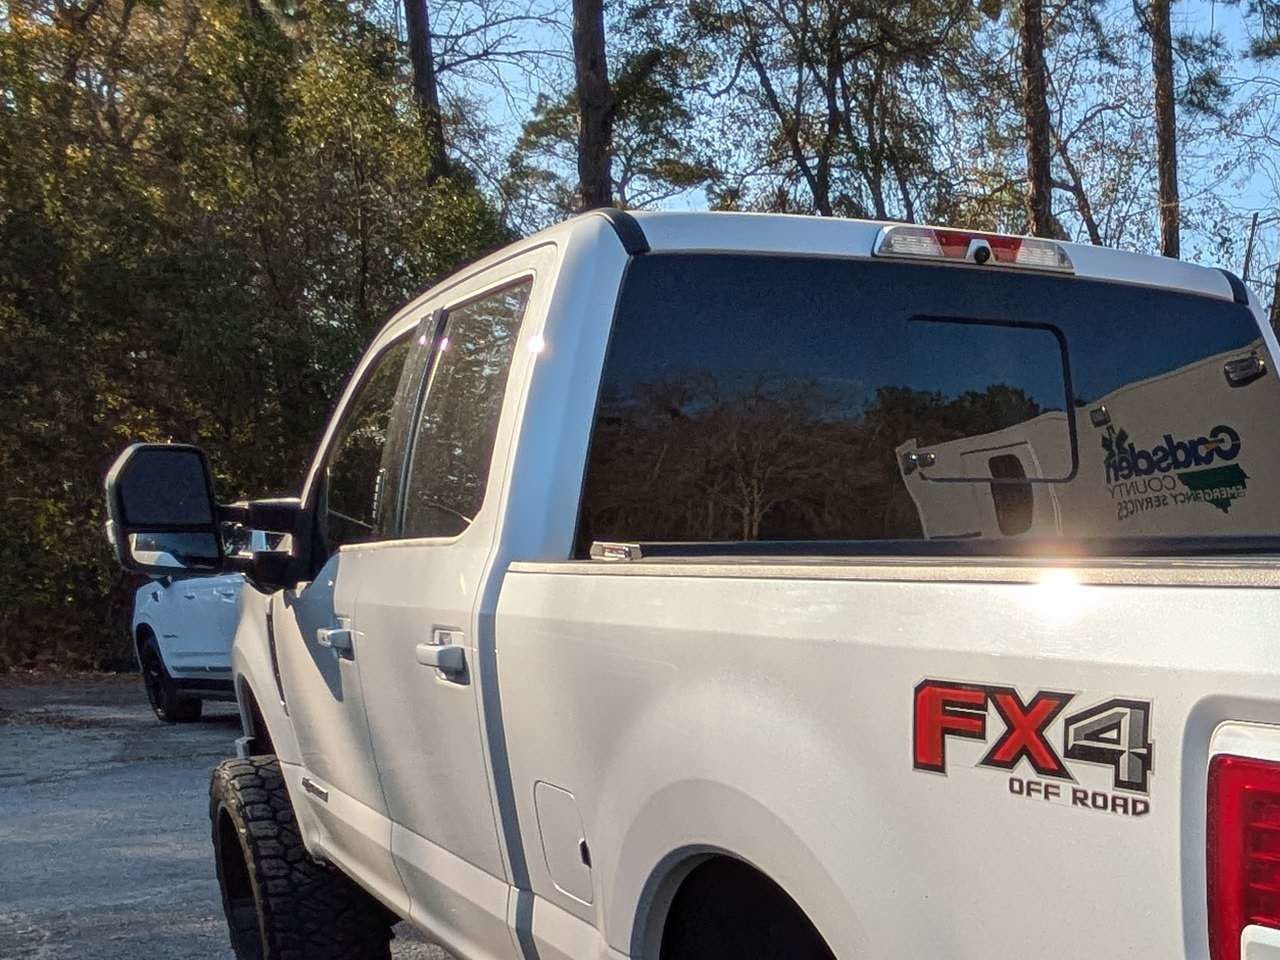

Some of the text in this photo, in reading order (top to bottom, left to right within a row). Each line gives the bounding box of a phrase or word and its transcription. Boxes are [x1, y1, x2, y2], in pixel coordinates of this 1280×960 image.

[913, 679, 1154, 793] FX4
[1008, 777, 1150, 816] OFF ROAD
